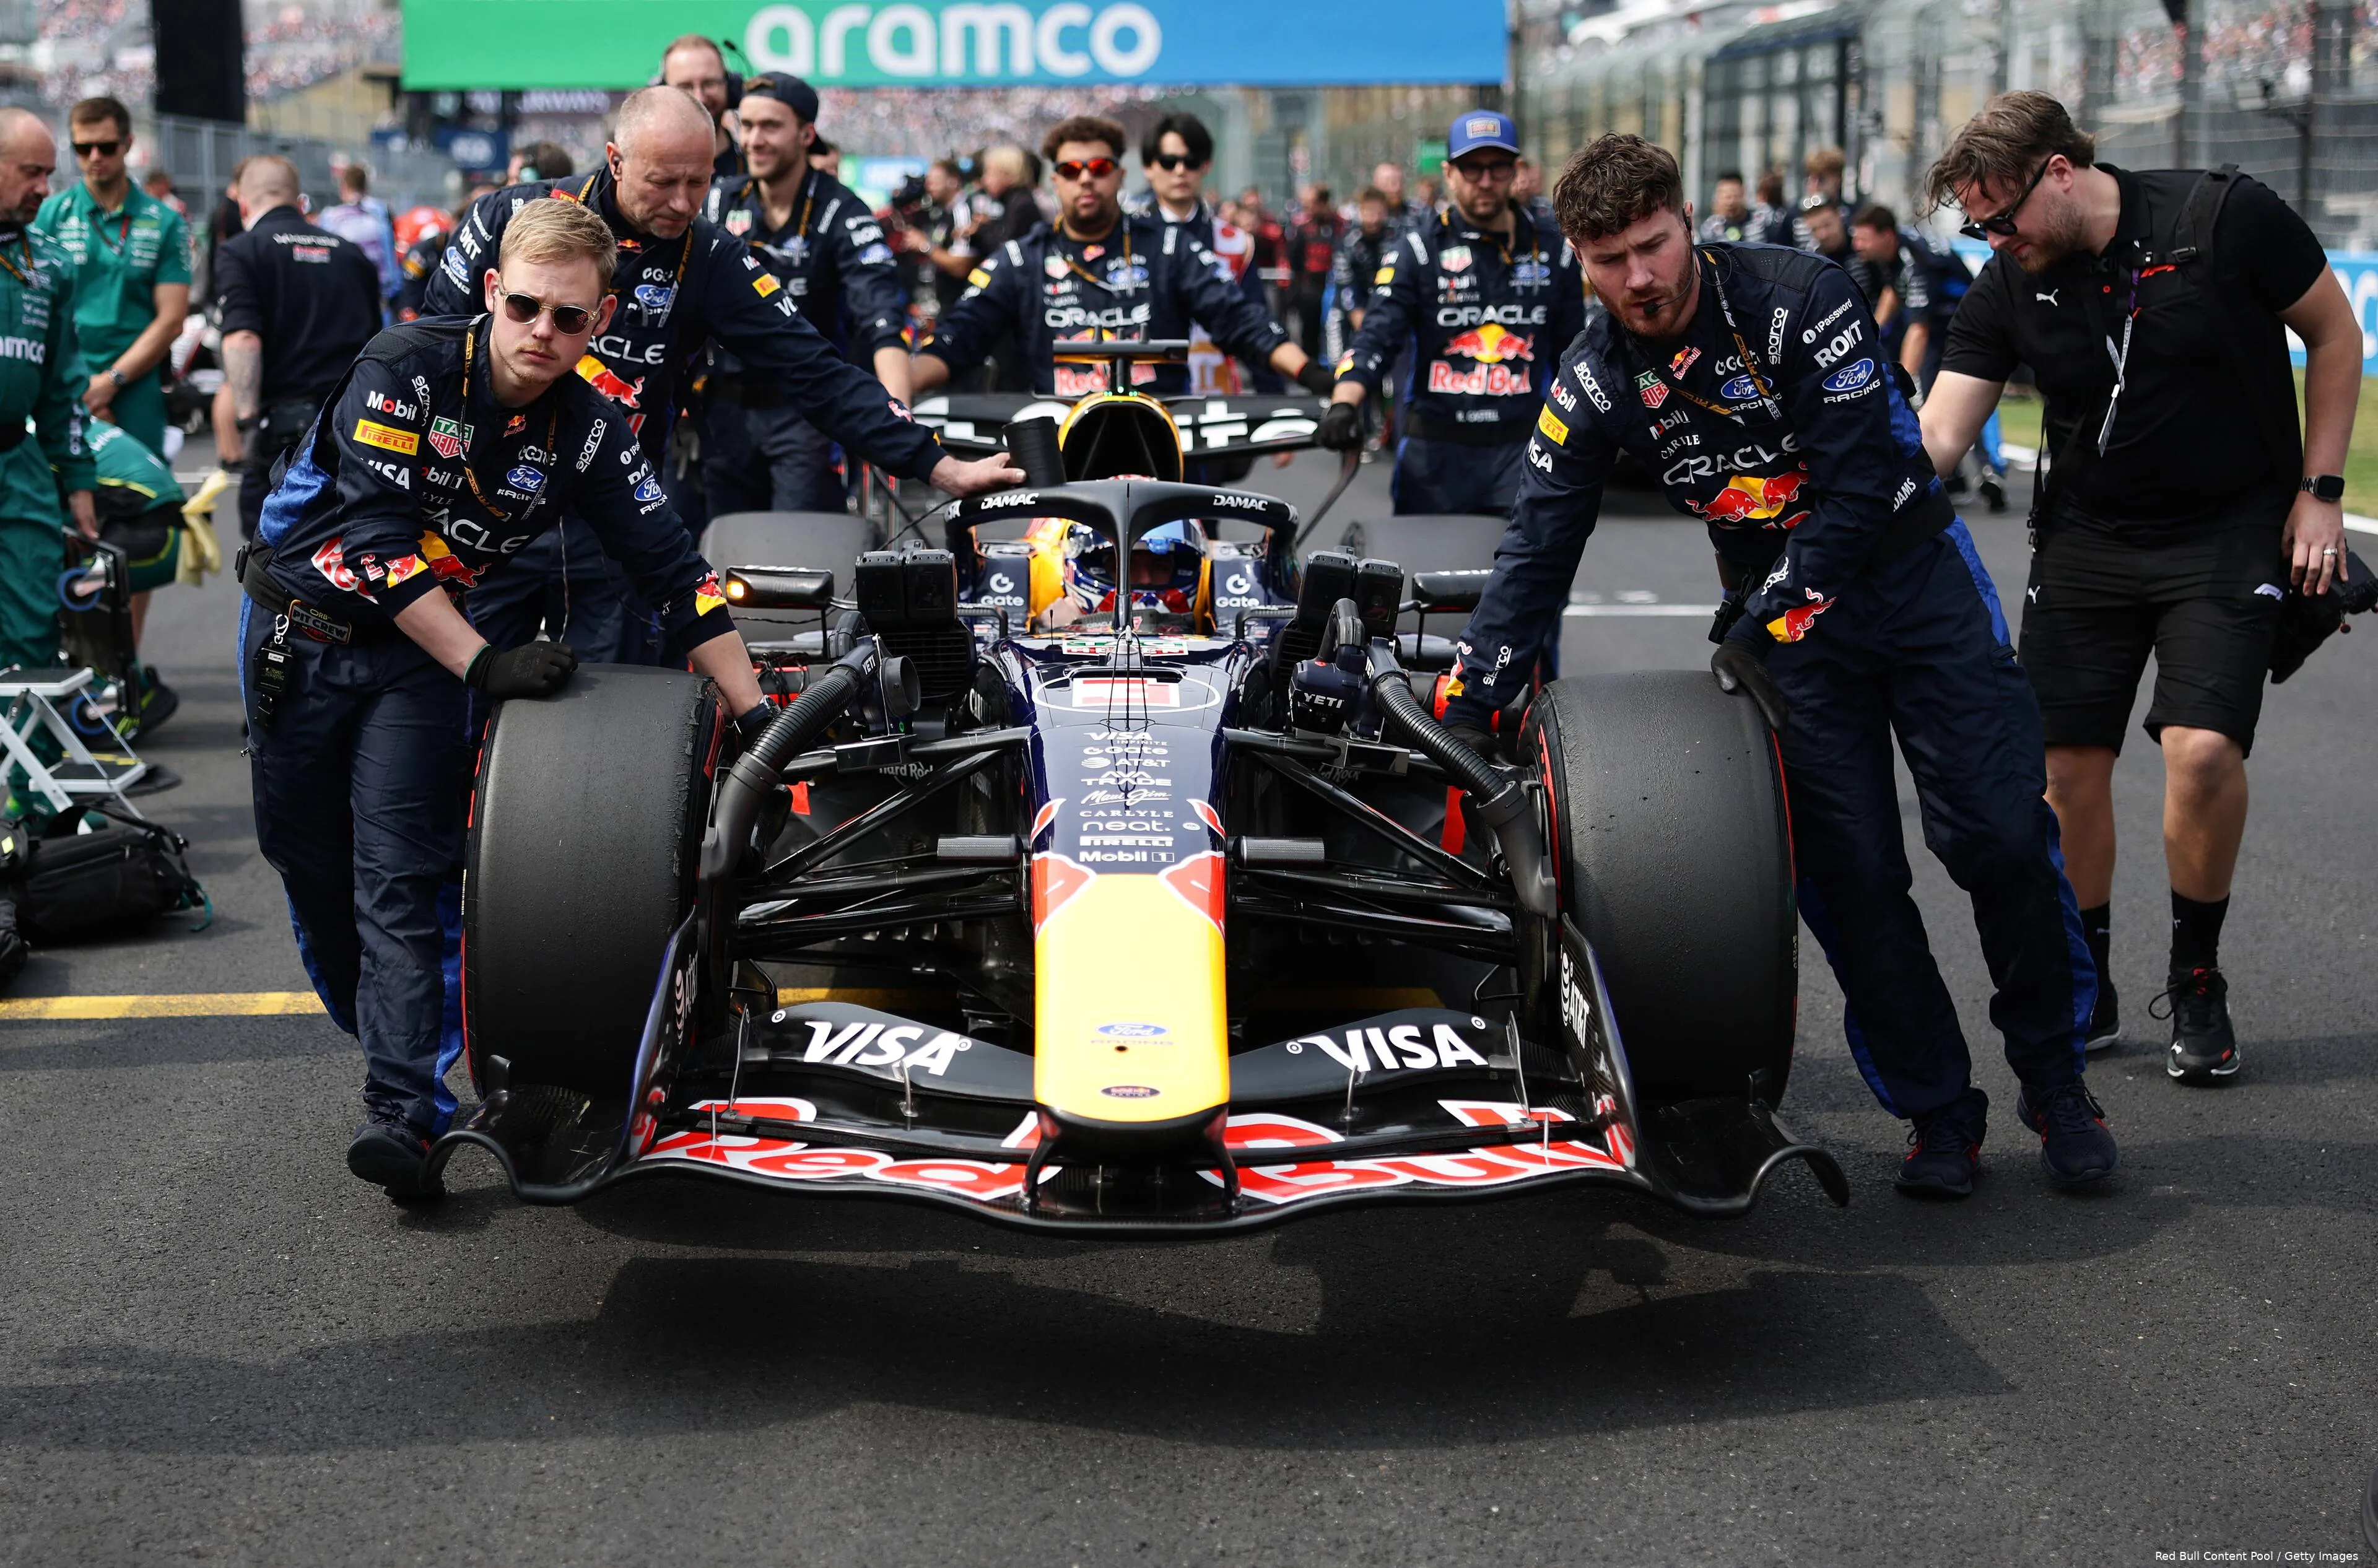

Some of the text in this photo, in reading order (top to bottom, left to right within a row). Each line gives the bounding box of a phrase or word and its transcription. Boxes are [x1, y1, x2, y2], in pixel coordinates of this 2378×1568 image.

[746, 3, 1162, 77] aramco
[459, 220, 482, 260] OKT
[1045, 303, 1151, 328] ORACLE
[1437, 305, 1548, 326] ORACLE
[1814, 298, 1852, 333] 1Password
[1768, 308, 1789, 365] sparco
[1814, 320, 1862, 368] ROKT
[0, 336, 46, 364] mco
[588, 336, 666, 365] ACLE
[1674, 347, 1702, 380] Red Bull
[1836, 364, 1867, 388] Ford
[1053, 363, 1112, 396] Red
[1428, 360, 1488, 395] Red
[1573, 362, 1611, 414] sparco
[1640, 383, 1668, 406] EUER
[1823, 379, 1881, 404] RACING
[367, 390, 417, 420] Mobil
[361, 425, 415, 451] PIRELLI
[576, 419, 608, 473] sparco
[1528, 436, 1553, 473] SA
[360, 458, 409, 490] SA
[421, 466, 451, 486] bil
[422, 491, 455, 505] LYLE
[981, 493, 1039, 510] DAMAC
[1213, 495, 1268, 511] DAMAC
[1893, 477, 1917, 513] DAMS
[420, 507, 531, 554] ACLE
[980, 595, 1025, 607] Gate
[1216, 595, 1260, 608] Gate
[293, 608, 311, 624] PIT
[311, 619, 347, 638] CREW
[862, 655, 876, 675] YETI
[1365, 656, 1375, 679] YET
[1483, 646, 1512, 687] srco
[1304, 692, 1345, 709] YETI
[1084, 731, 1152, 741] VISA
[1105, 746, 1169, 755] Gate
[1115, 758, 1171, 767] AT&T
[1081, 778, 1172, 786] TRADE
[1081, 788, 1172, 806] Maui Jim
[1079, 810, 1174, 818] CARLYLE
[1082, 821, 1171, 832] neat.
[1079, 835, 1174, 847] PIRELLI
[1079, 851, 1147, 861] Mobil
[1569, 981, 1590, 1049] AT&T
[804, 1021, 960, 1076] VISA
[1297, 1024, 1489, 1073] VISA
